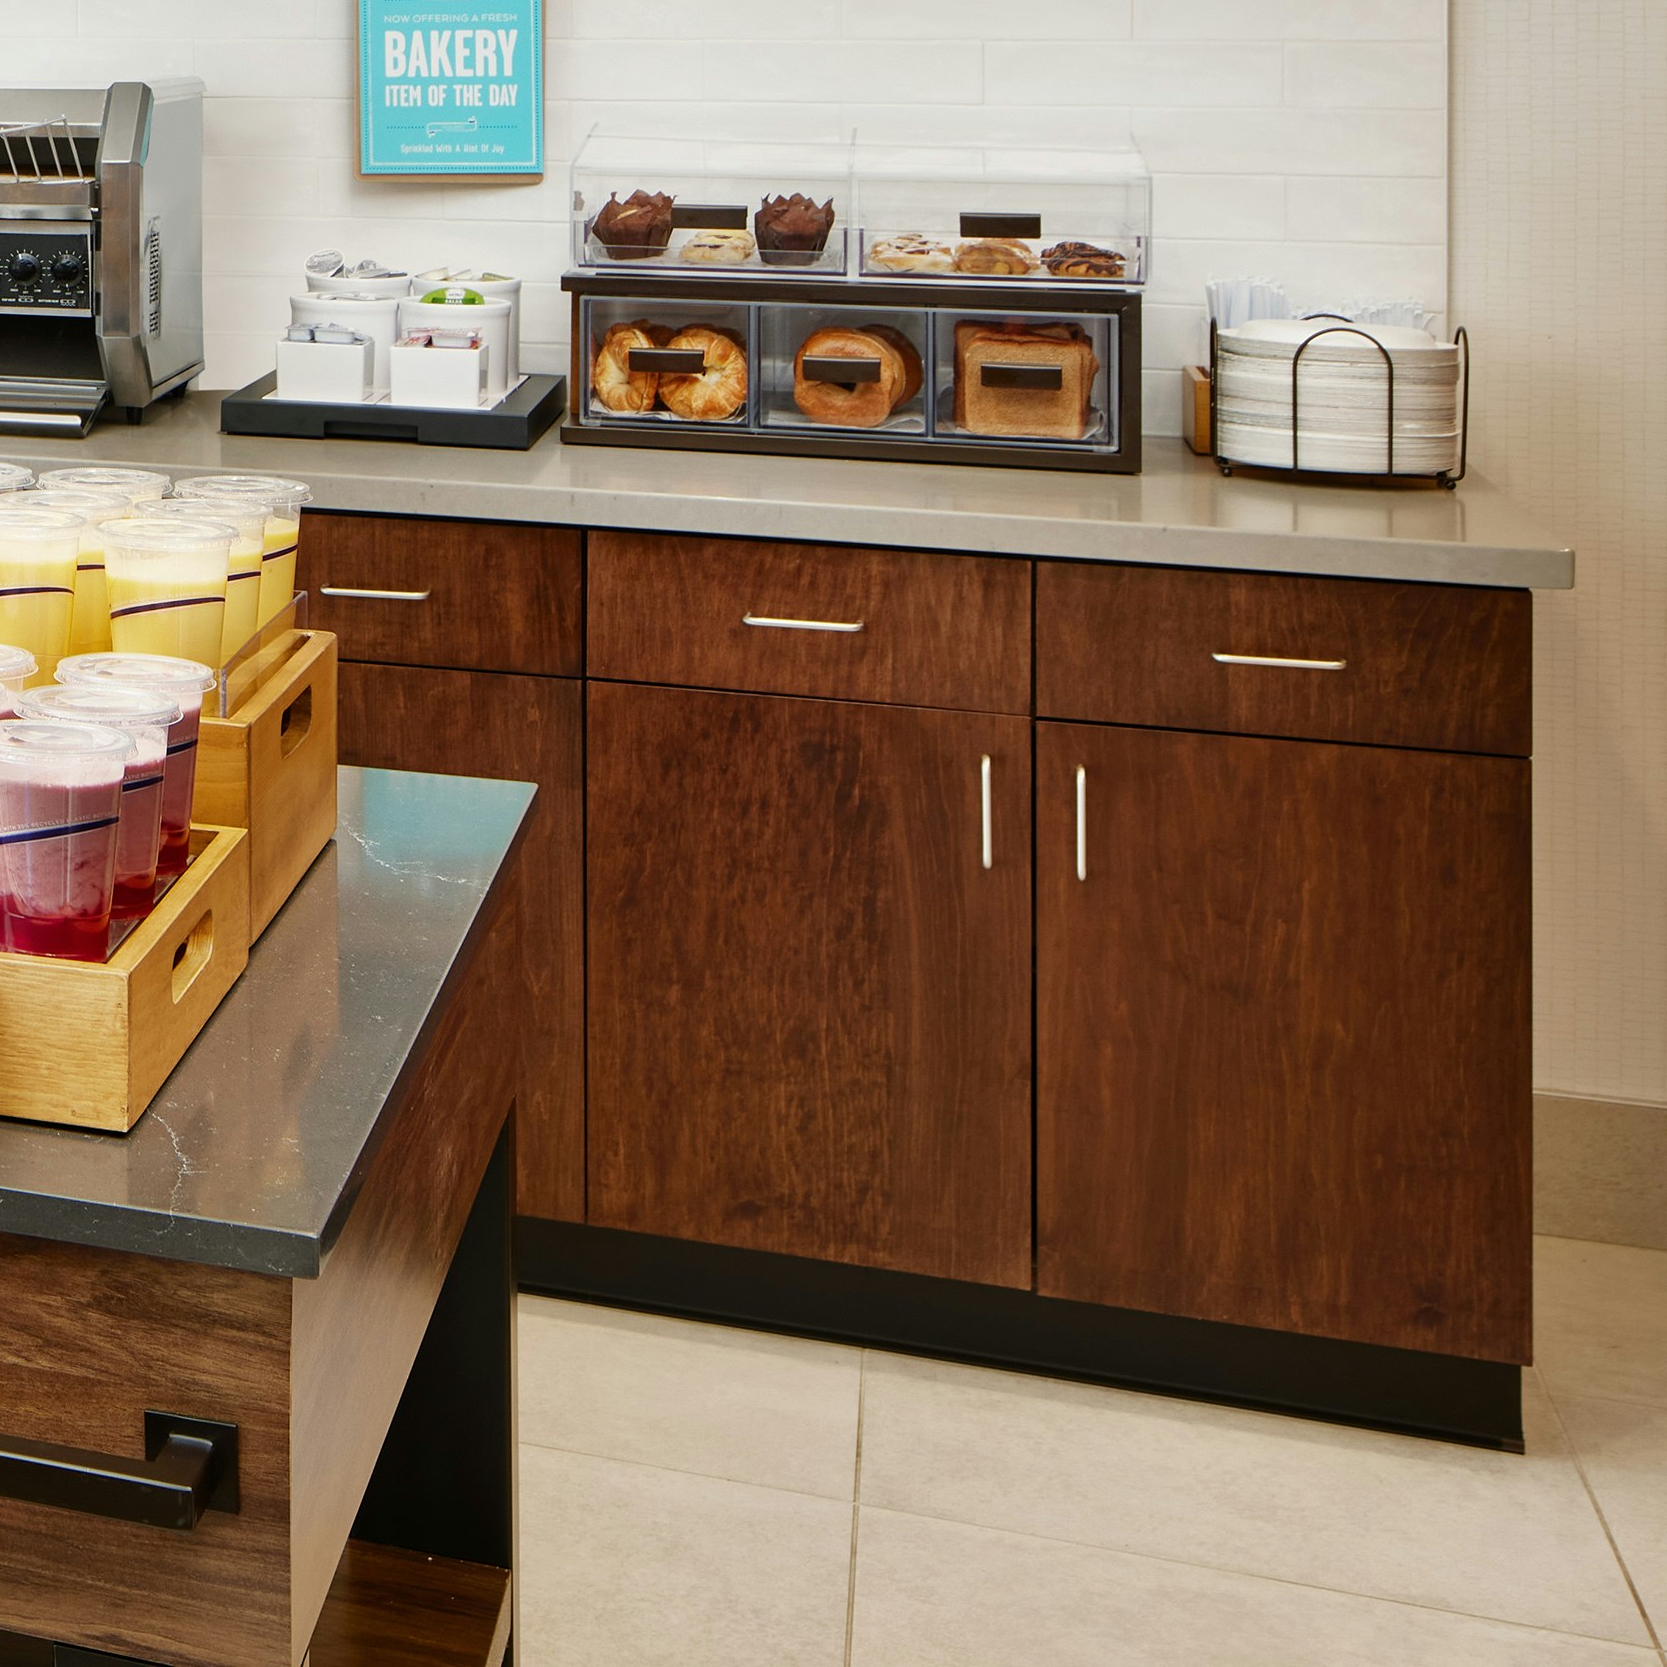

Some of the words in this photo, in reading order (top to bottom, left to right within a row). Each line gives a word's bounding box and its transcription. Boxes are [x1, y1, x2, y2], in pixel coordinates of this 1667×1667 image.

[384, 14, 410, 23] NOW
[413, 13, 468, 23] OFFERING
[471, 14, 479, 22] A
[481, 13, 517, 22] FRESH
[384, 29, 517, 78] BAKERY
[385, 85, 421, 107] ITEM
[428, 84, 447, 107] OF
[453, 84, 483, 106] THE
[489, 84, 517, 107] DAY
